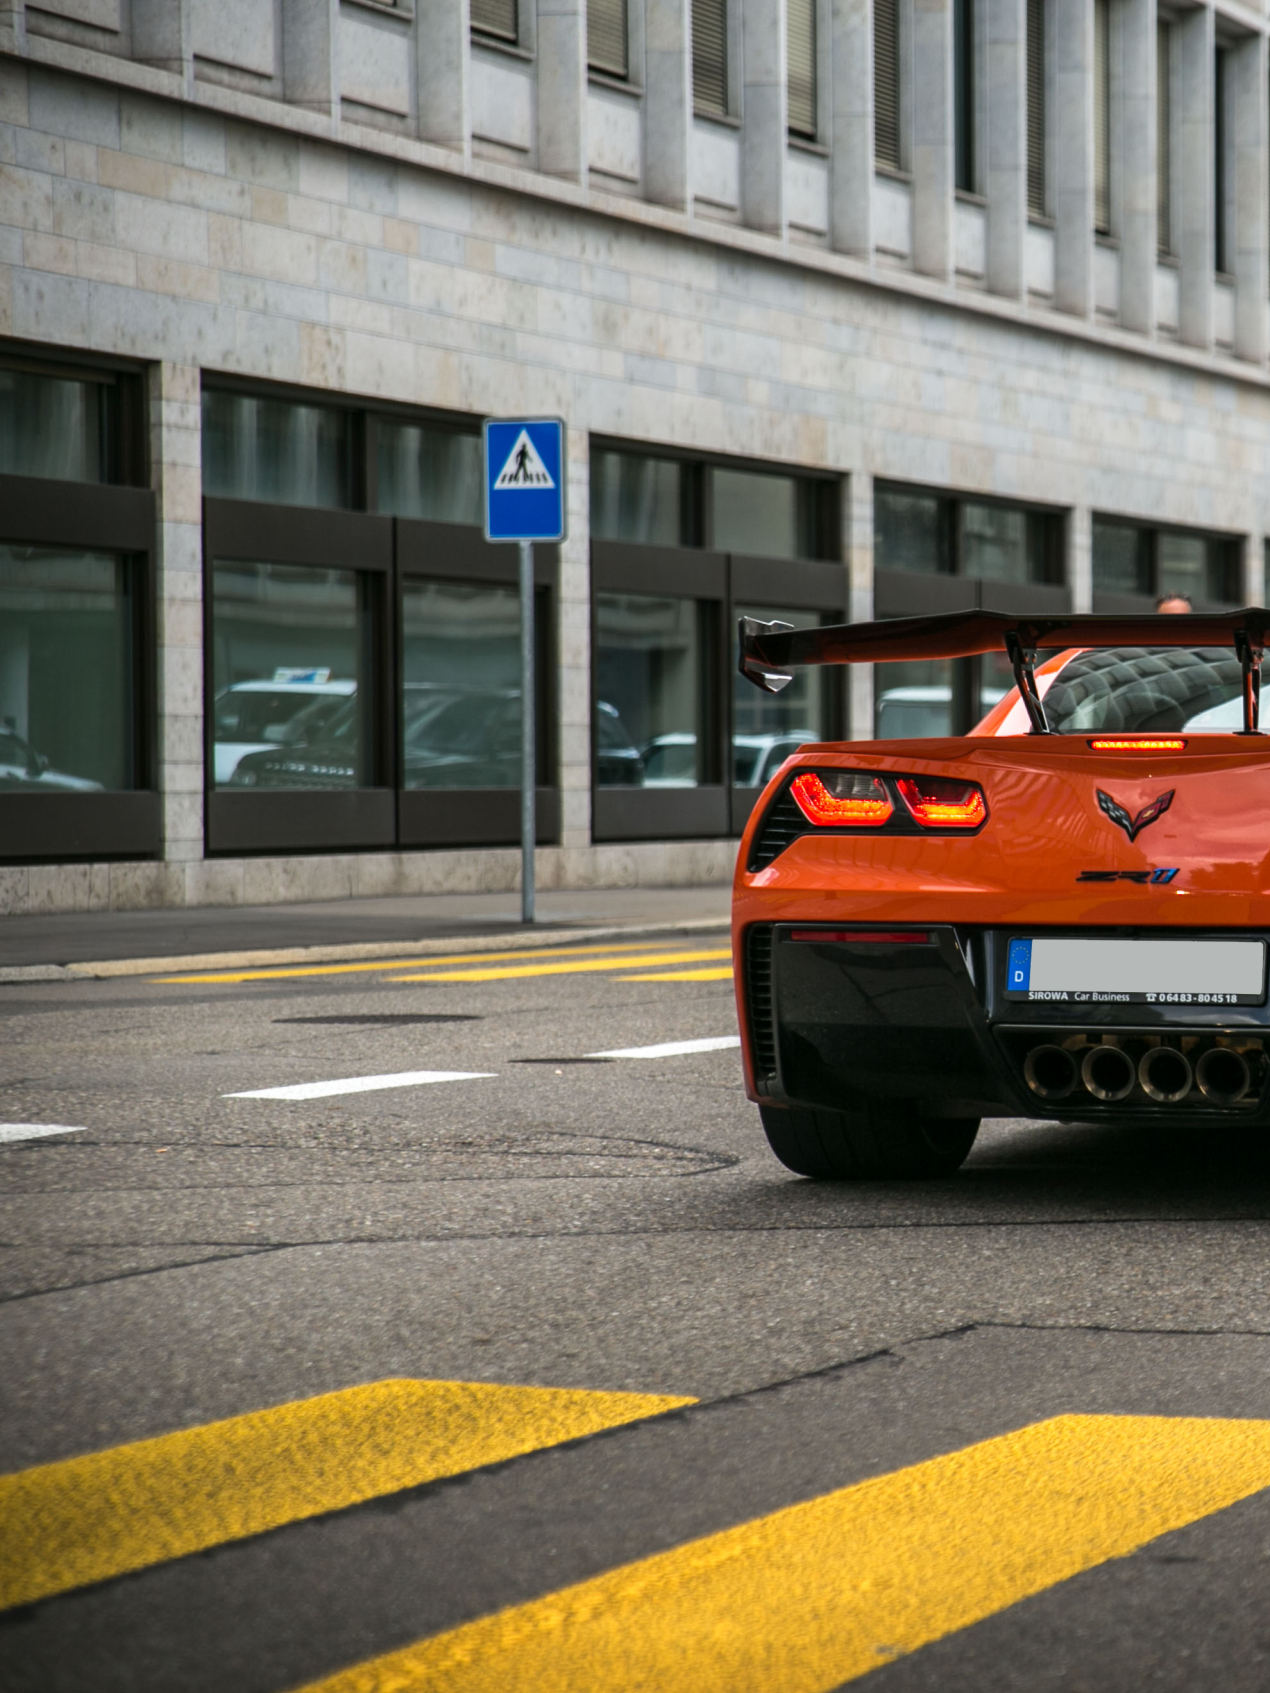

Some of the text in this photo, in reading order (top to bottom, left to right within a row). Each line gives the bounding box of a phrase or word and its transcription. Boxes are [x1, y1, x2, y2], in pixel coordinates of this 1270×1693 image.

[1014, 970, 1024, 983] D
[1028, 991, 1069, 1001] SIROWA
[1074, 992, 1090, 1001] Car
[1092, 993, 1130, 1002] Business
